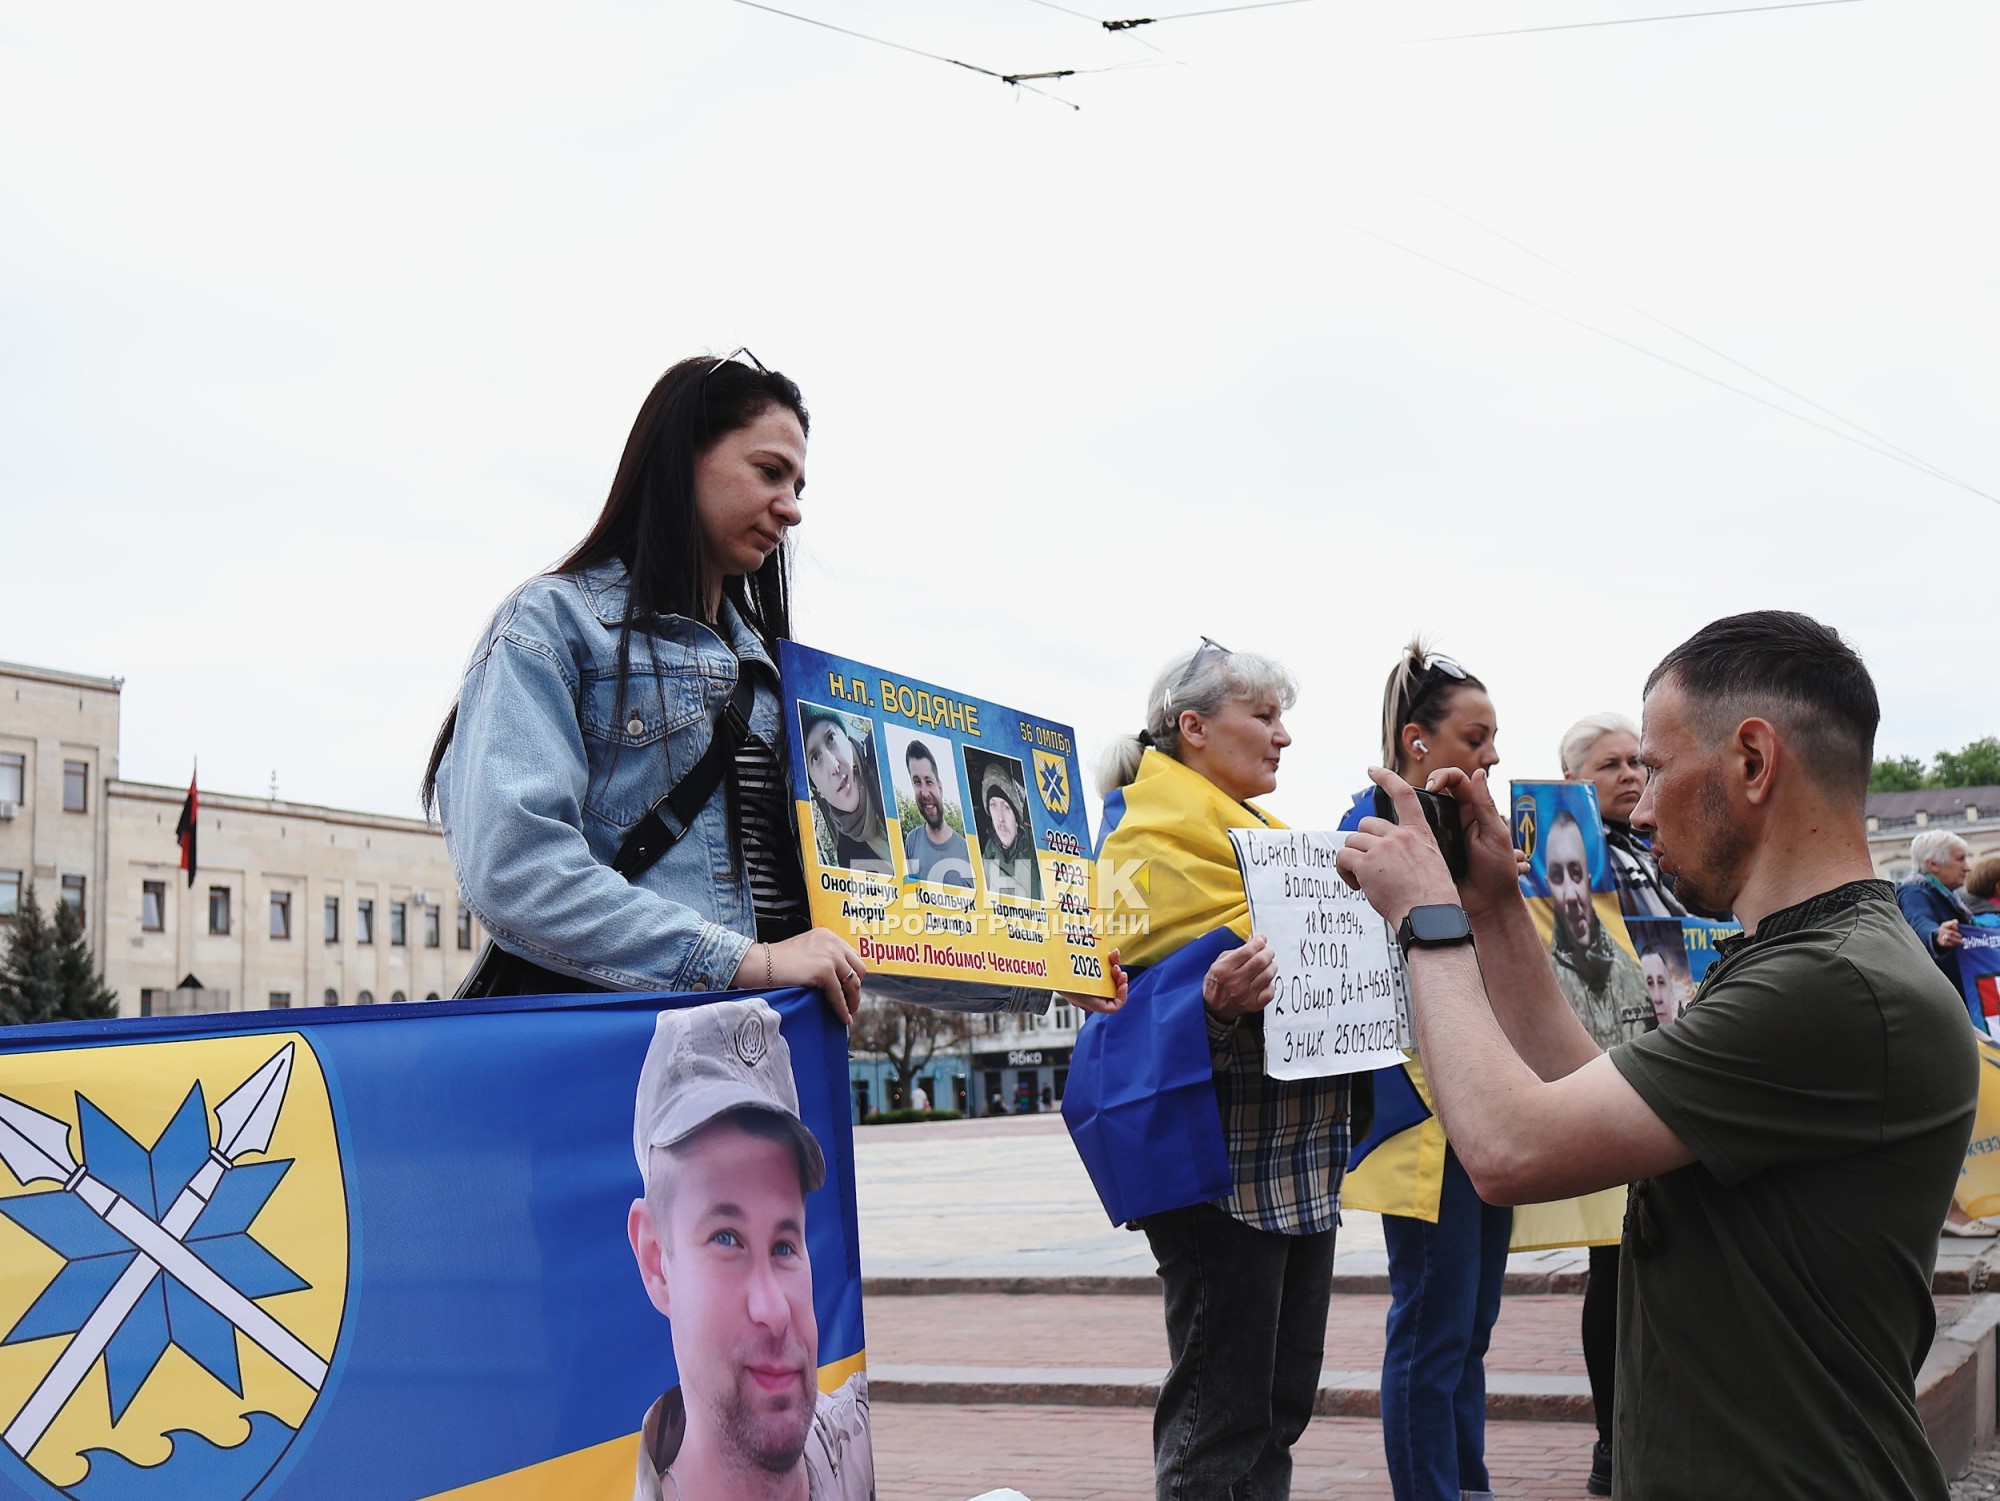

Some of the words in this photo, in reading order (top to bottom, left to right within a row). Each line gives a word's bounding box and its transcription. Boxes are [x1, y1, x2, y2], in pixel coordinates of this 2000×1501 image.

[880, 679, 982, 737] ВОДЯНЕ
[1019, 722, 1034, 742] 56
[1036, 726, 1072, 756] ОМПБр
[1048, 831, 1080, 856] 2022
[1302, 833, 1337, 868] Олекс
[1052, 860, 1085, 886] 2023
[820, 873, 899, 901] Онофрійчук
[915, 887, 976, 912] Ковальчук
[842, 900, 886, 924] Андрій
[991, 900, 1047, 923] Тартачний
[1058, 891, 1090, 917] 2024
[925, 913, 972, 936] Дмитро
[1007, 924, 1044, 943] Василь
[1065, 922, 1097, 948] 2025
[859, 937, 920, 965] Віримо!
[923, 943, 987, 972] Любимо!
[988, 951, 1048, 978] Чекаємо!
[1070, 953, 1102, 979] 2026
